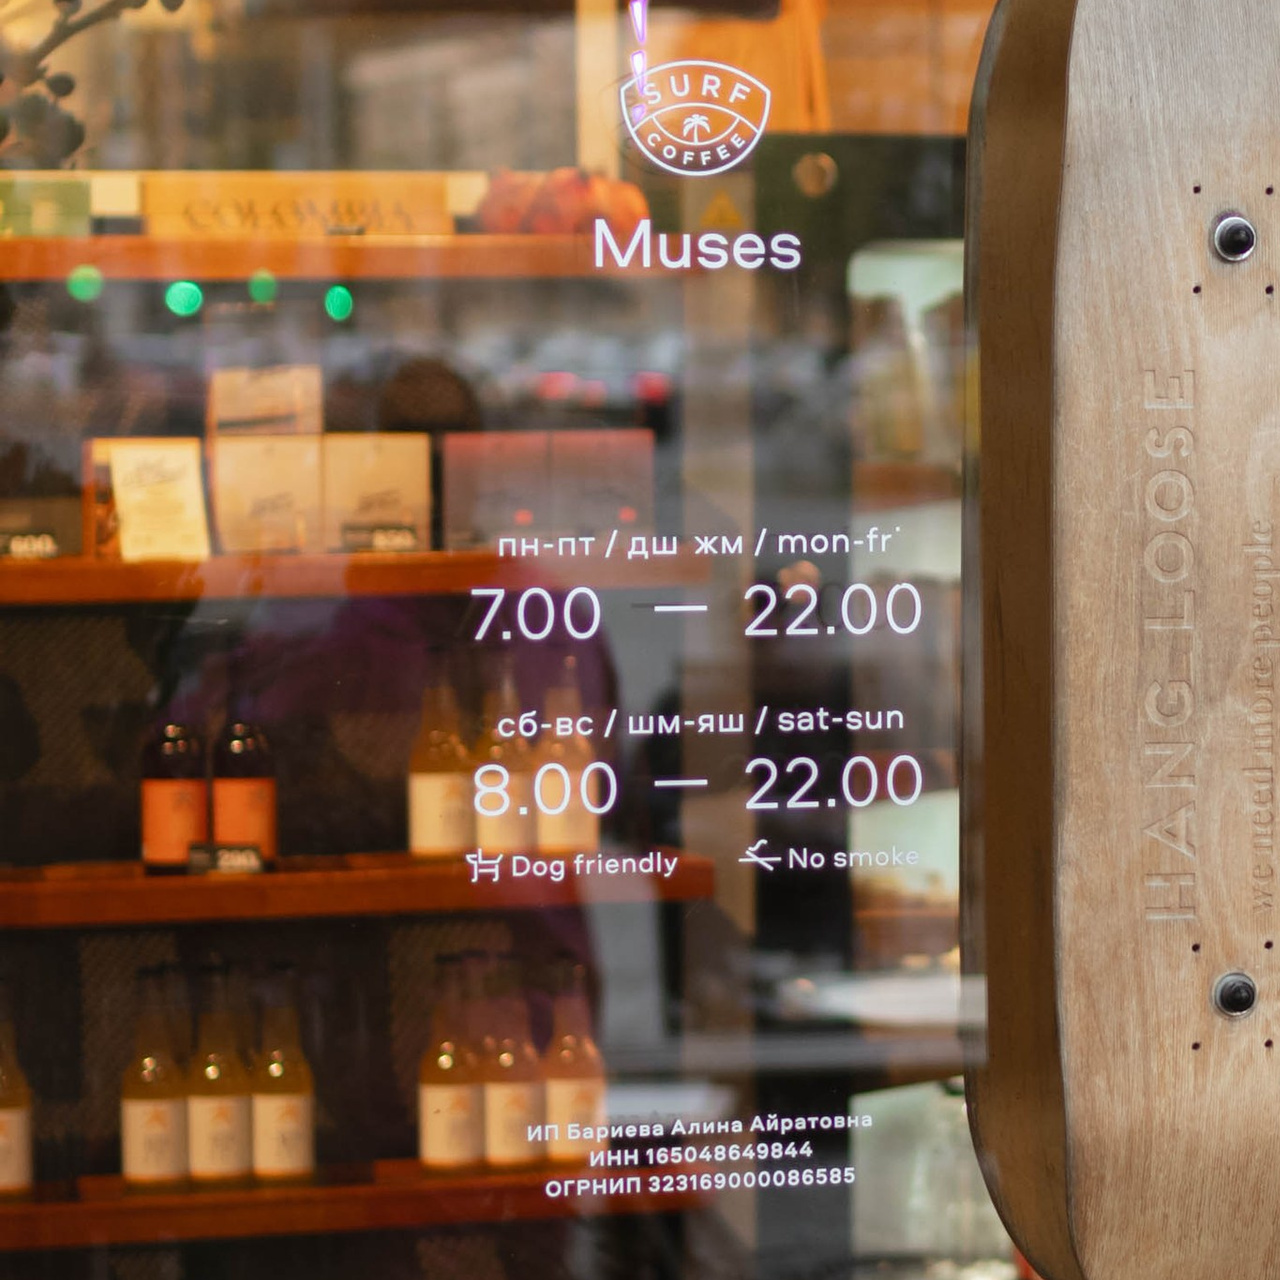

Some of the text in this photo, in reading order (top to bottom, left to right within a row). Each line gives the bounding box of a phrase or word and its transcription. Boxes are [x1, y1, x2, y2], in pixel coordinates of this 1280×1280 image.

[643, 73, 751, 105] SURF
[646, 132, 746, 166] COFFEE
[595, 218, 803, 269] Muses
[498, 536, 596, 557] пн-пт
[627, 536, 678, 560] дш
[694, 535, 743, 555] жм
[778, 526, 901, 554] mon-fr
[471, 586, 601, 640] 7.00
[744, 582, 922, 636] 22.00
[1143, 369, 1197, 922] HANG LOOSE
[497, 710, 594, 737] сб-вс
[628, 713, 744, 734] шм-яш
[778, 707, 904, 732] sat-sun
[1248, 655, 1275, 755] more
[474, 762, 617, 817] 8.00
[745, 754, 923, 810] 22.00
[1241, 766, 1275, 854] need
[512, 852, 678, 882] Dog friendly
[789, 845, 920, 869] No smoke
[1248, 865, 1275, 915] we
[527, 1113, 874, 1143] ИП Бариева Алина Айратовна
[590, 1141, 813, 1168] ИНН 165048649844
[545, 1167, 856, 1198] ОГРНИП 323169000086585
